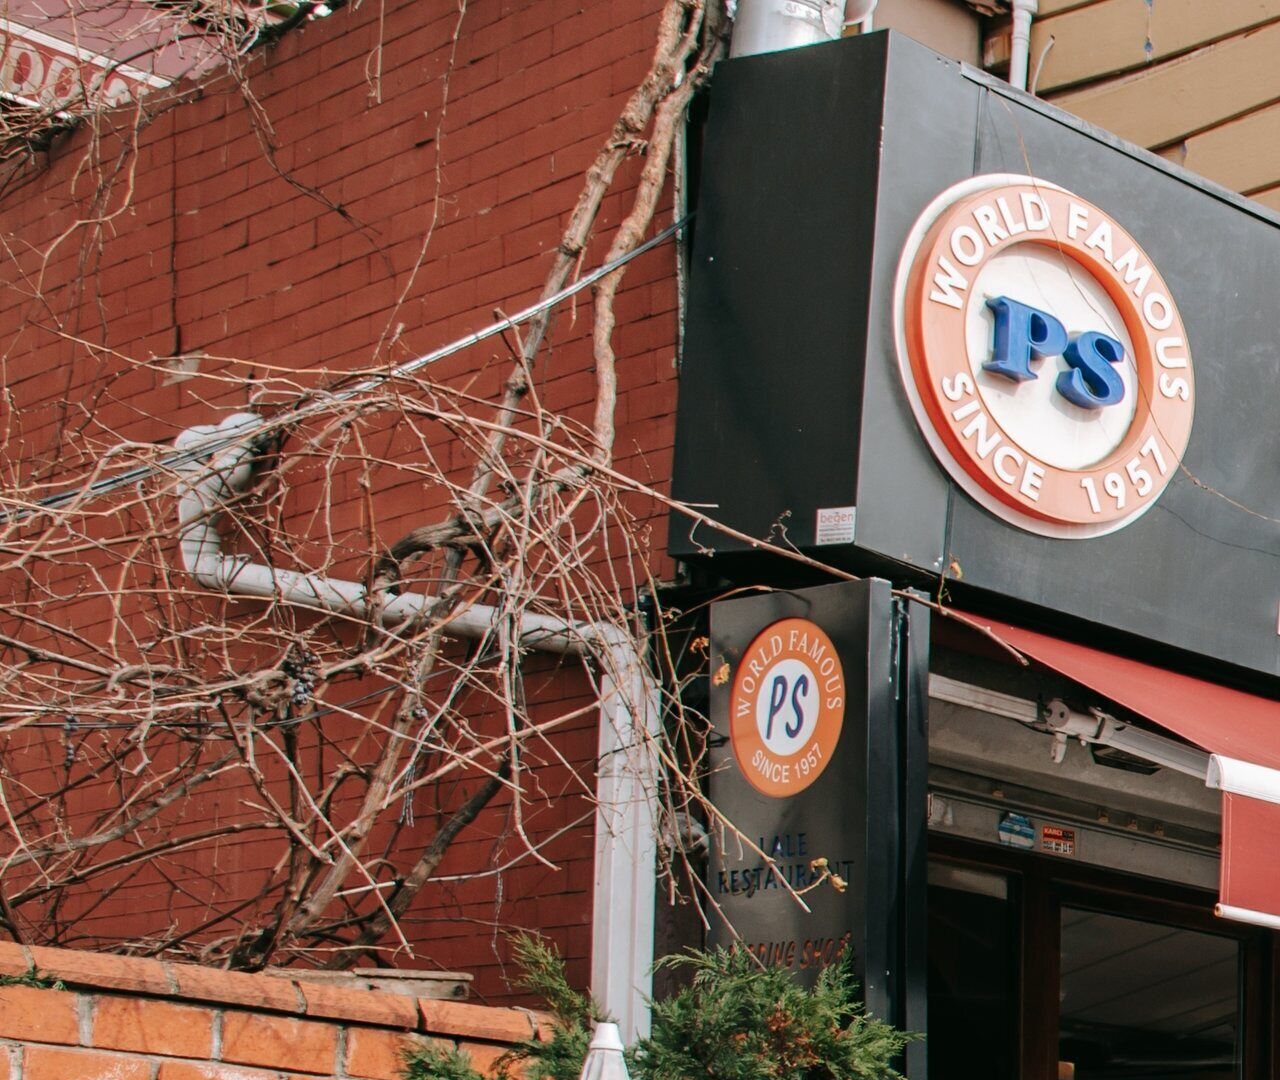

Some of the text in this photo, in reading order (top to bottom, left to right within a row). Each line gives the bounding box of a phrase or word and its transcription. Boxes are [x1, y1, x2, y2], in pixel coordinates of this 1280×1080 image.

[930, 190, 1191, 403] WORLD FAMOUS
[982, 294, 1126, 412] PS
[940, 370, 1169, 516] SINCE 1957
[736, 629, 844, 719] WORLD FAMOUS
[765, 674, 809, 741] PS
[751, 742, 825, 784] SINCE 1957
